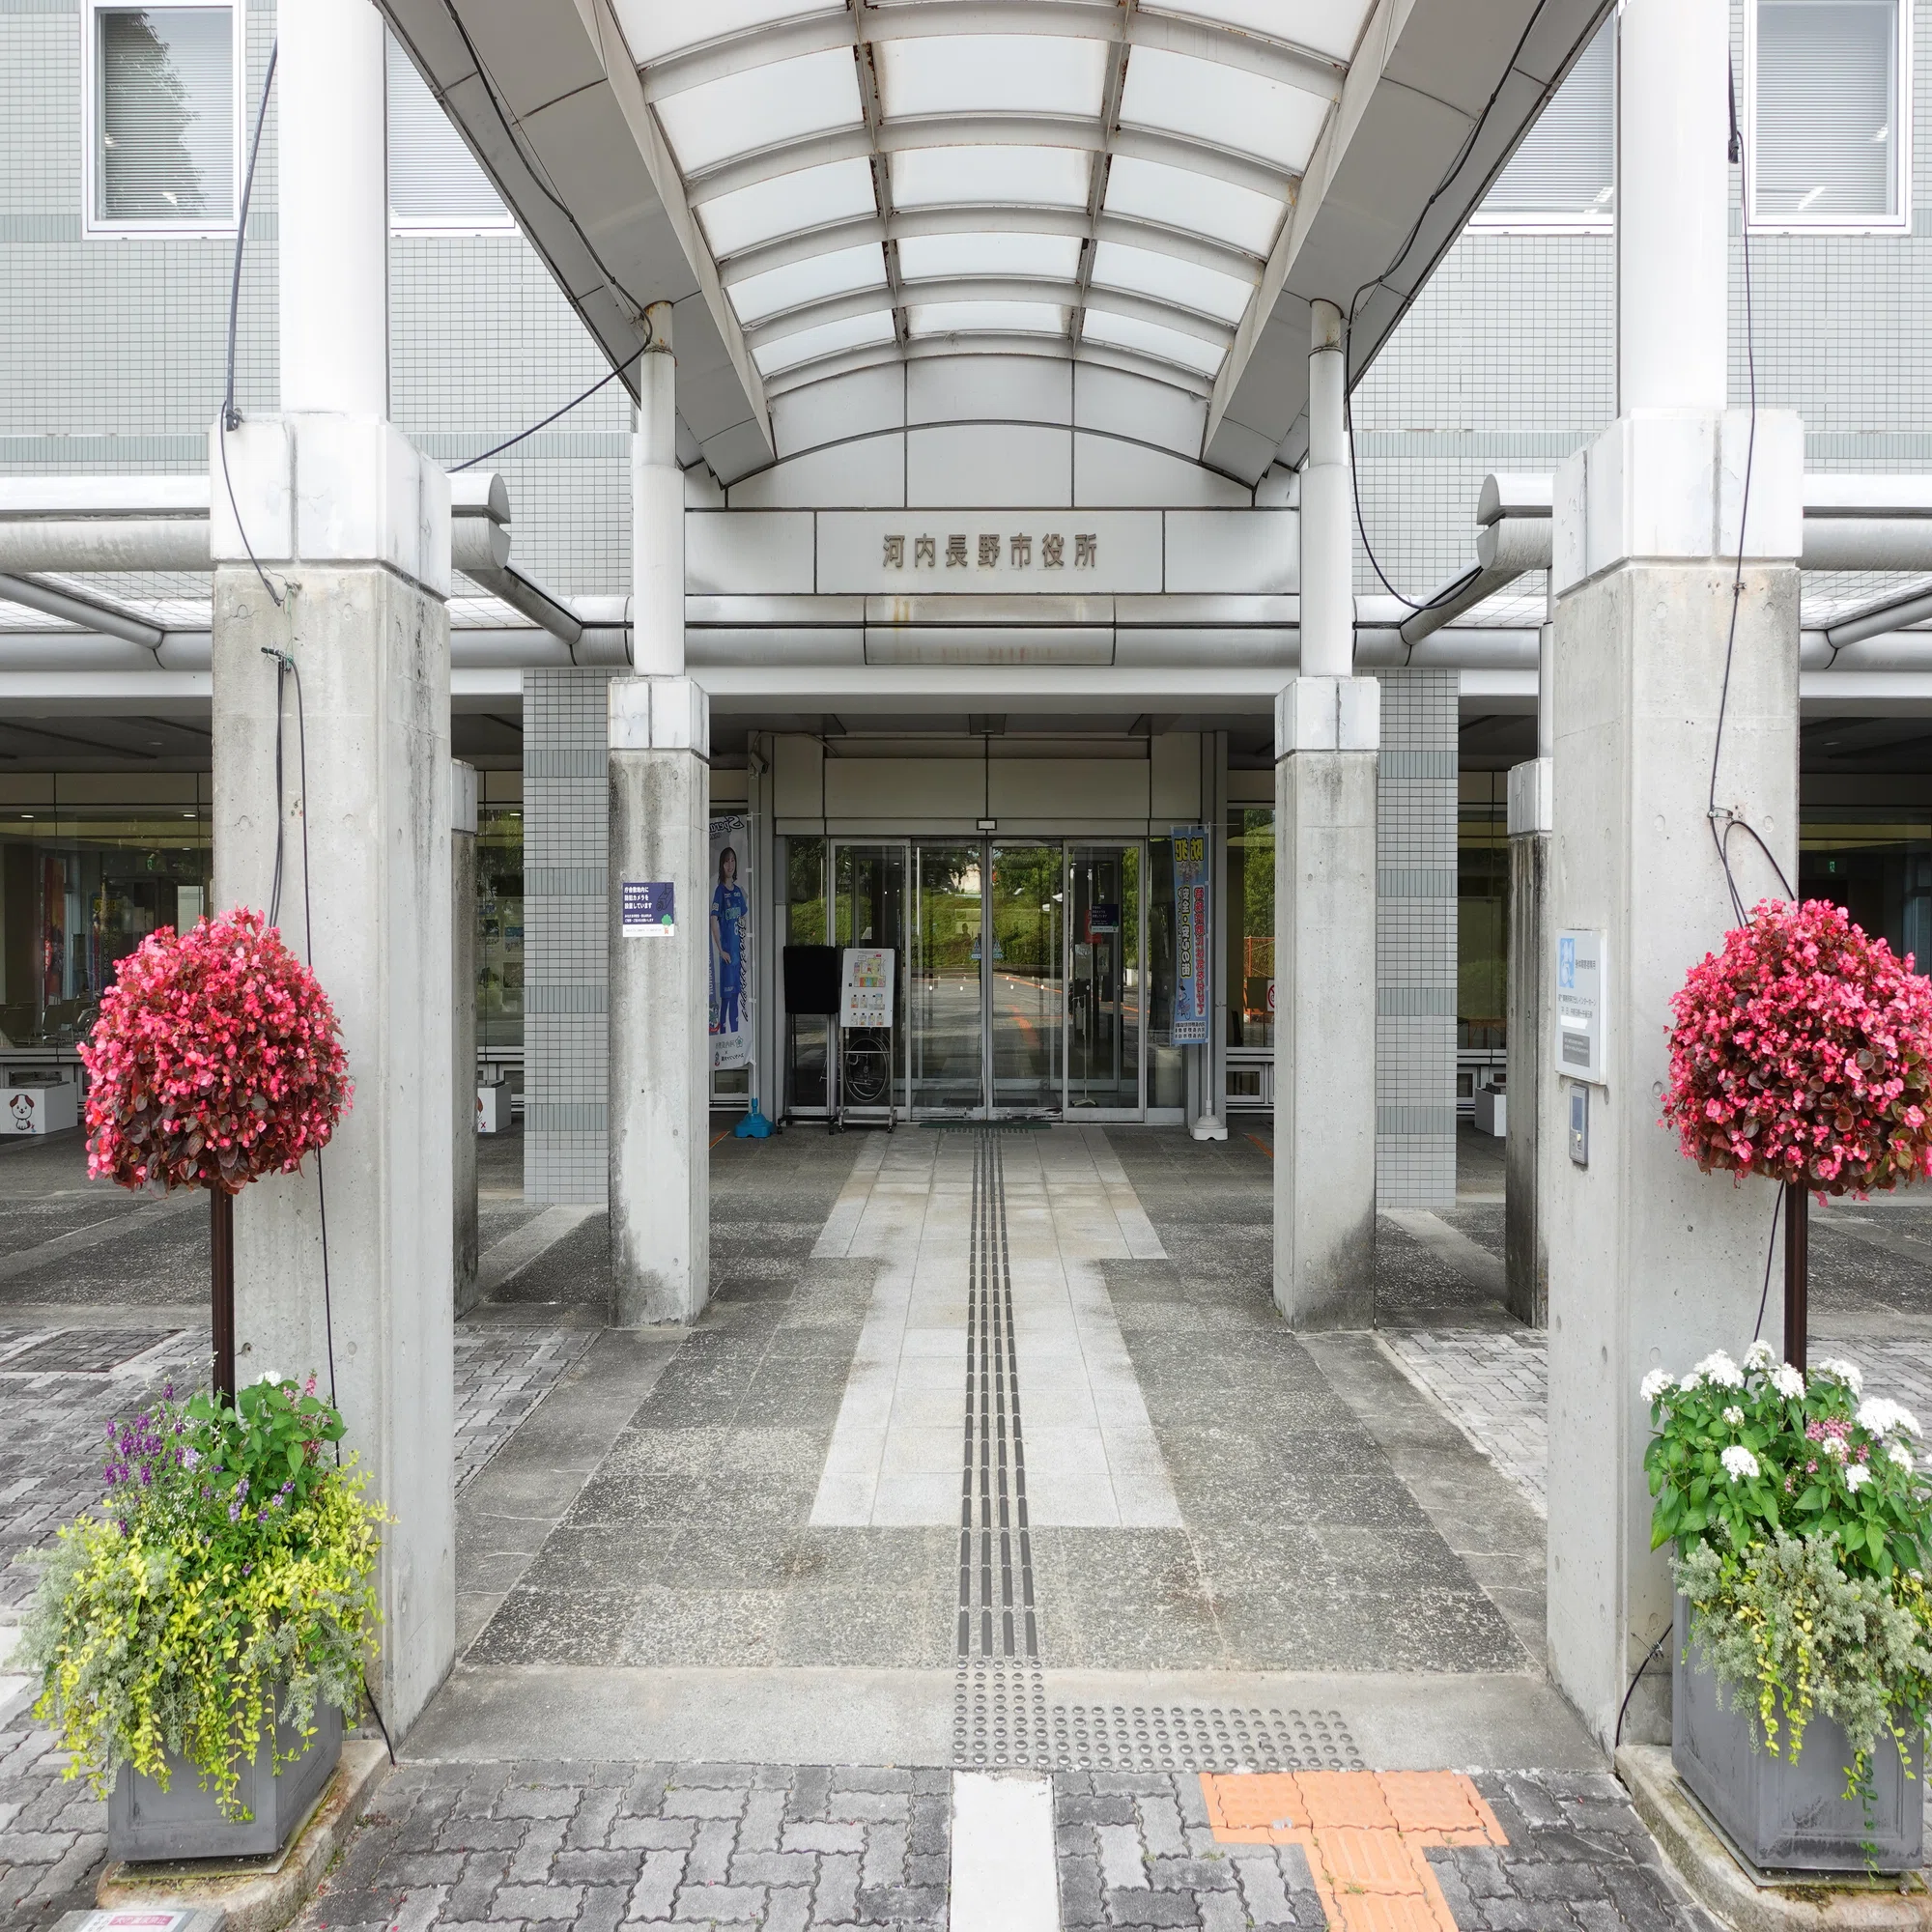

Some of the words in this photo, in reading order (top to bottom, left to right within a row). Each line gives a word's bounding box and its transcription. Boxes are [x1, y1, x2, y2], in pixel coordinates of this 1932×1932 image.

[883, 532, 1097, 568] 河内長野市役所
